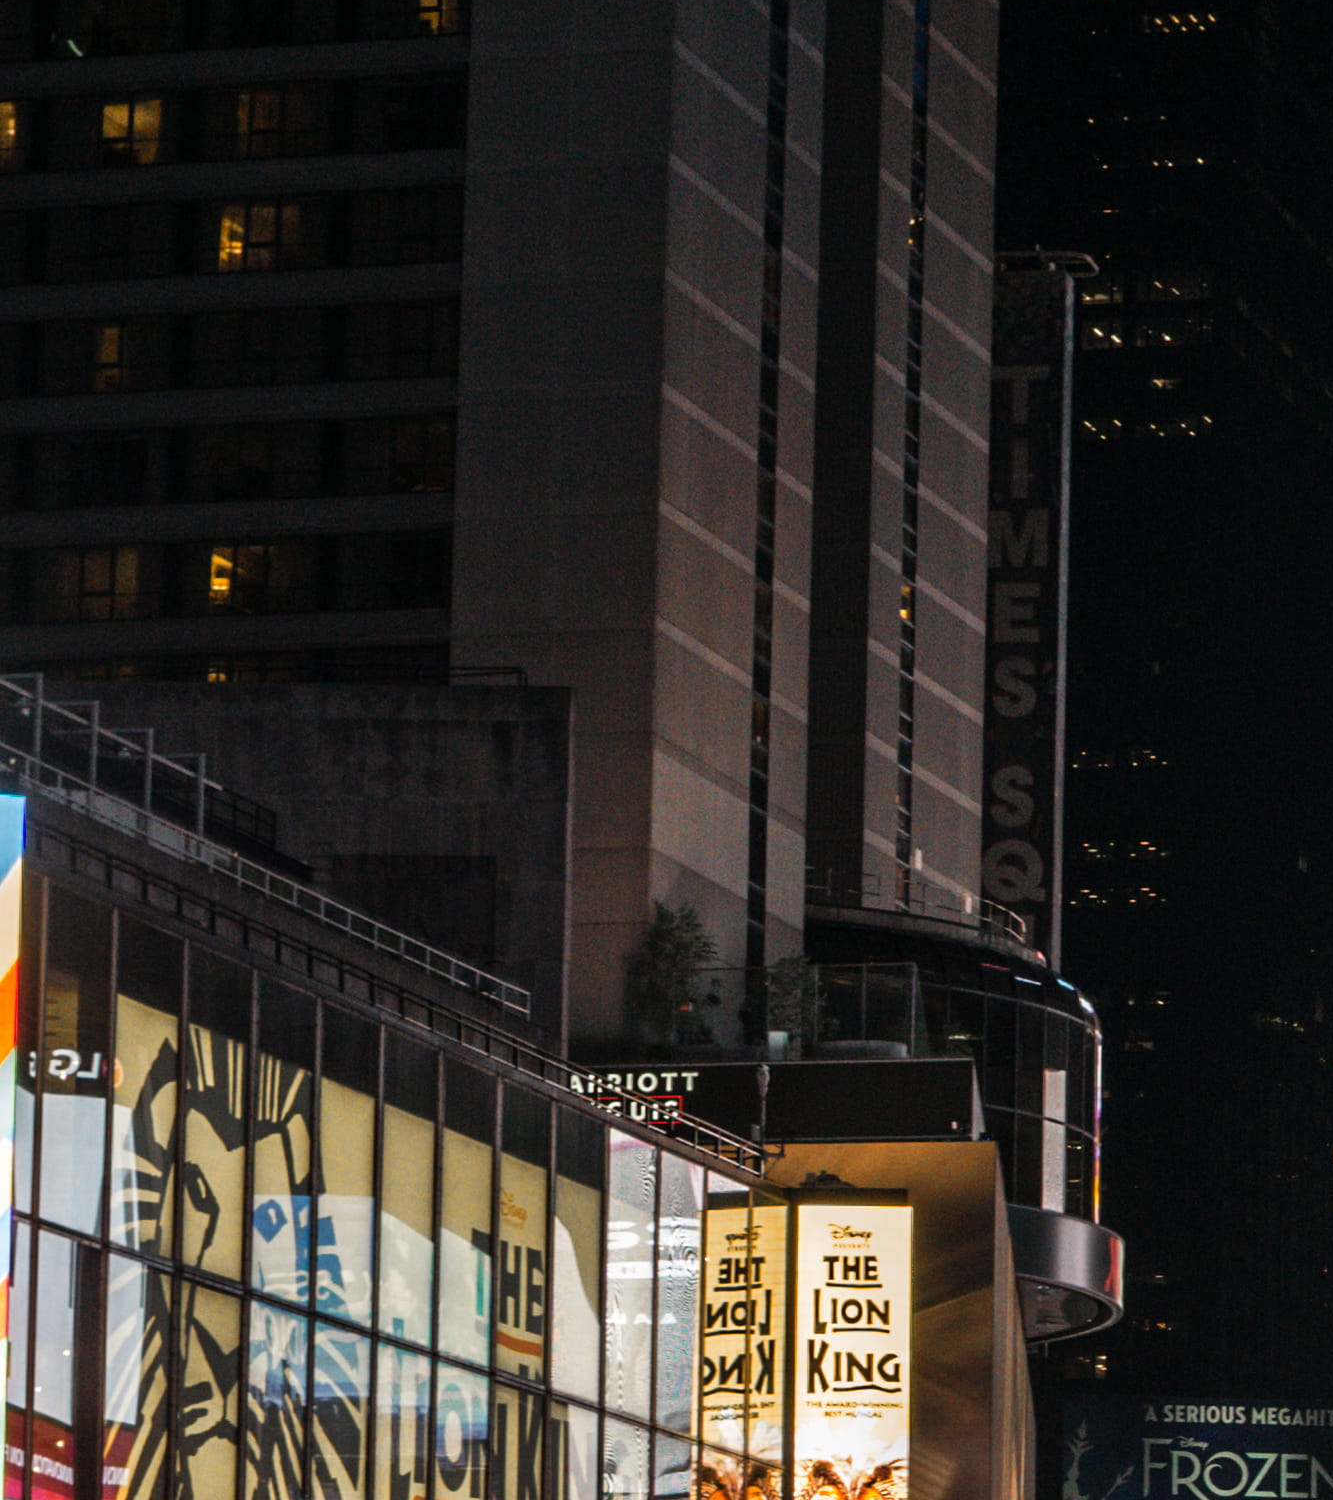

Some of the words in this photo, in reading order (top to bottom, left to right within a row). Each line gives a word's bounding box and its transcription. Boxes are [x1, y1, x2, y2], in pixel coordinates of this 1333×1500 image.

[990, 363, 1050, 720] TIMES
[823, 1255, 879, 1281] THE
[813, 1288, 890, 1335] LION
[806, 1338, 902, 1394] KING
[1163, 1405, 1246, 1425] SERIOUS
